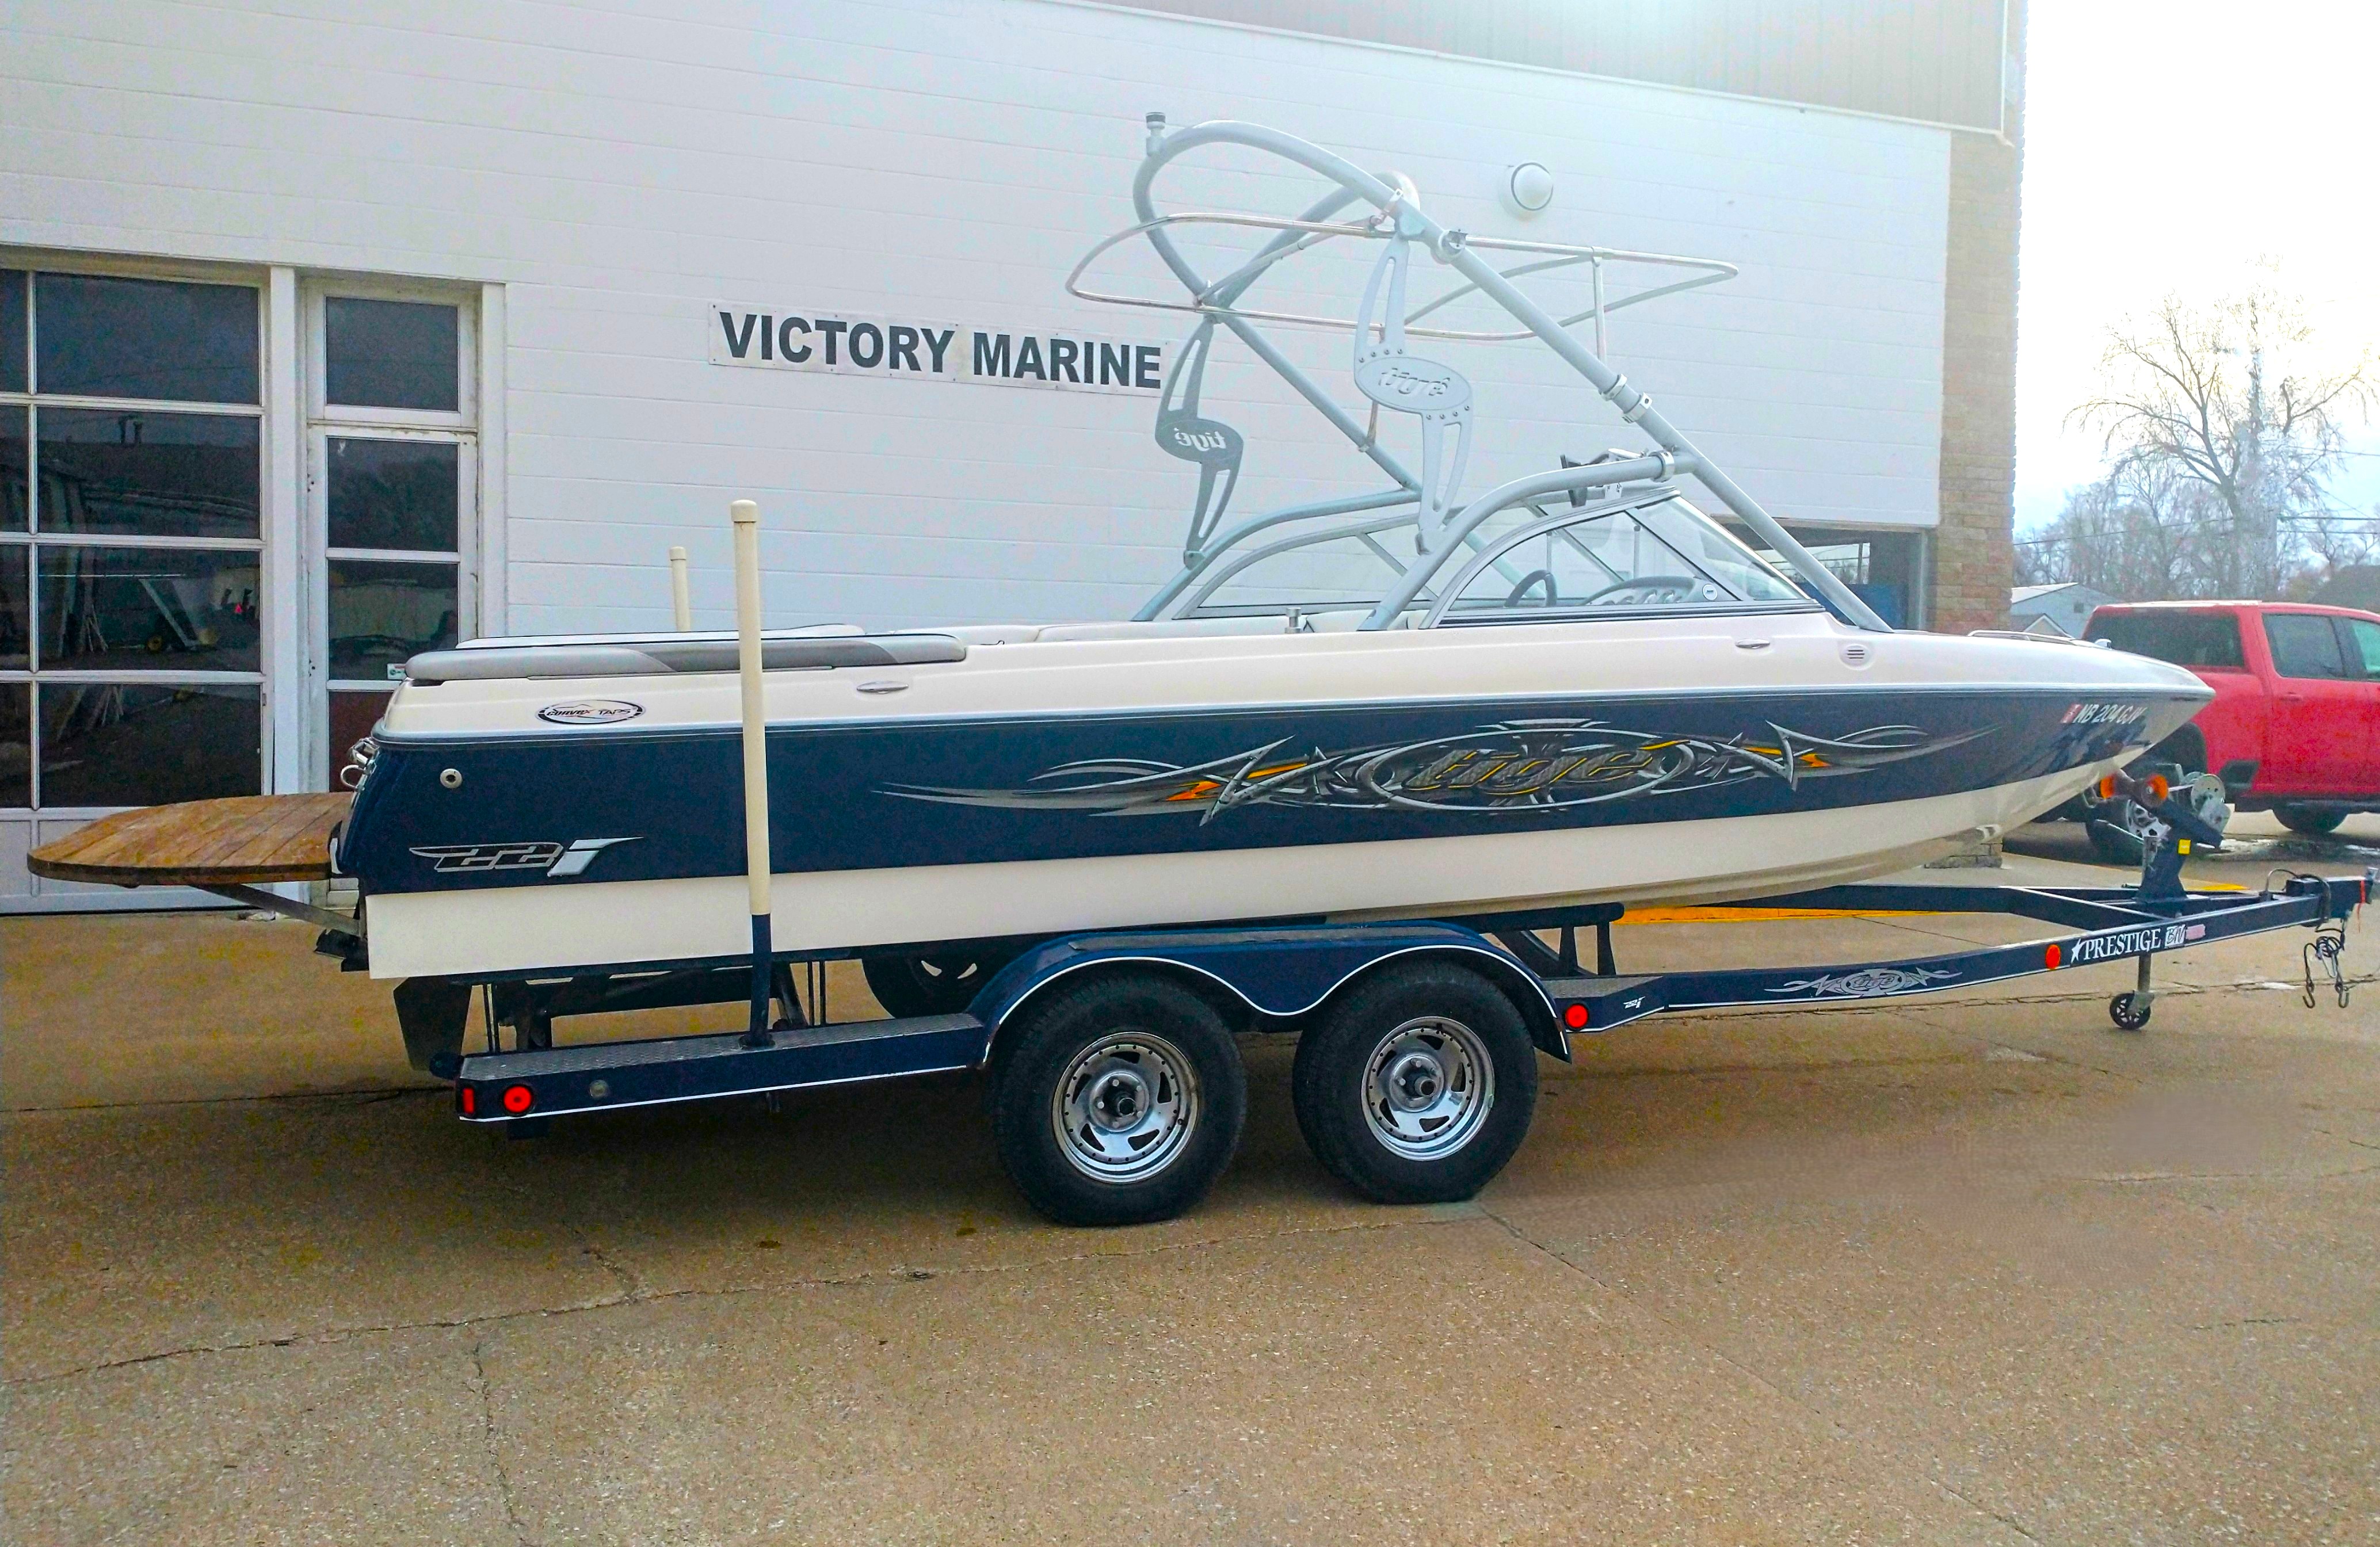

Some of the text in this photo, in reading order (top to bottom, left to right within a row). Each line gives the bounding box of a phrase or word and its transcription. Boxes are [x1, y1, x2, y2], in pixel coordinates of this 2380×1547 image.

[719, 311, 1162, 389] VICTORY MARINE
[2084, 927, 2162, 960] PRESTIGE
